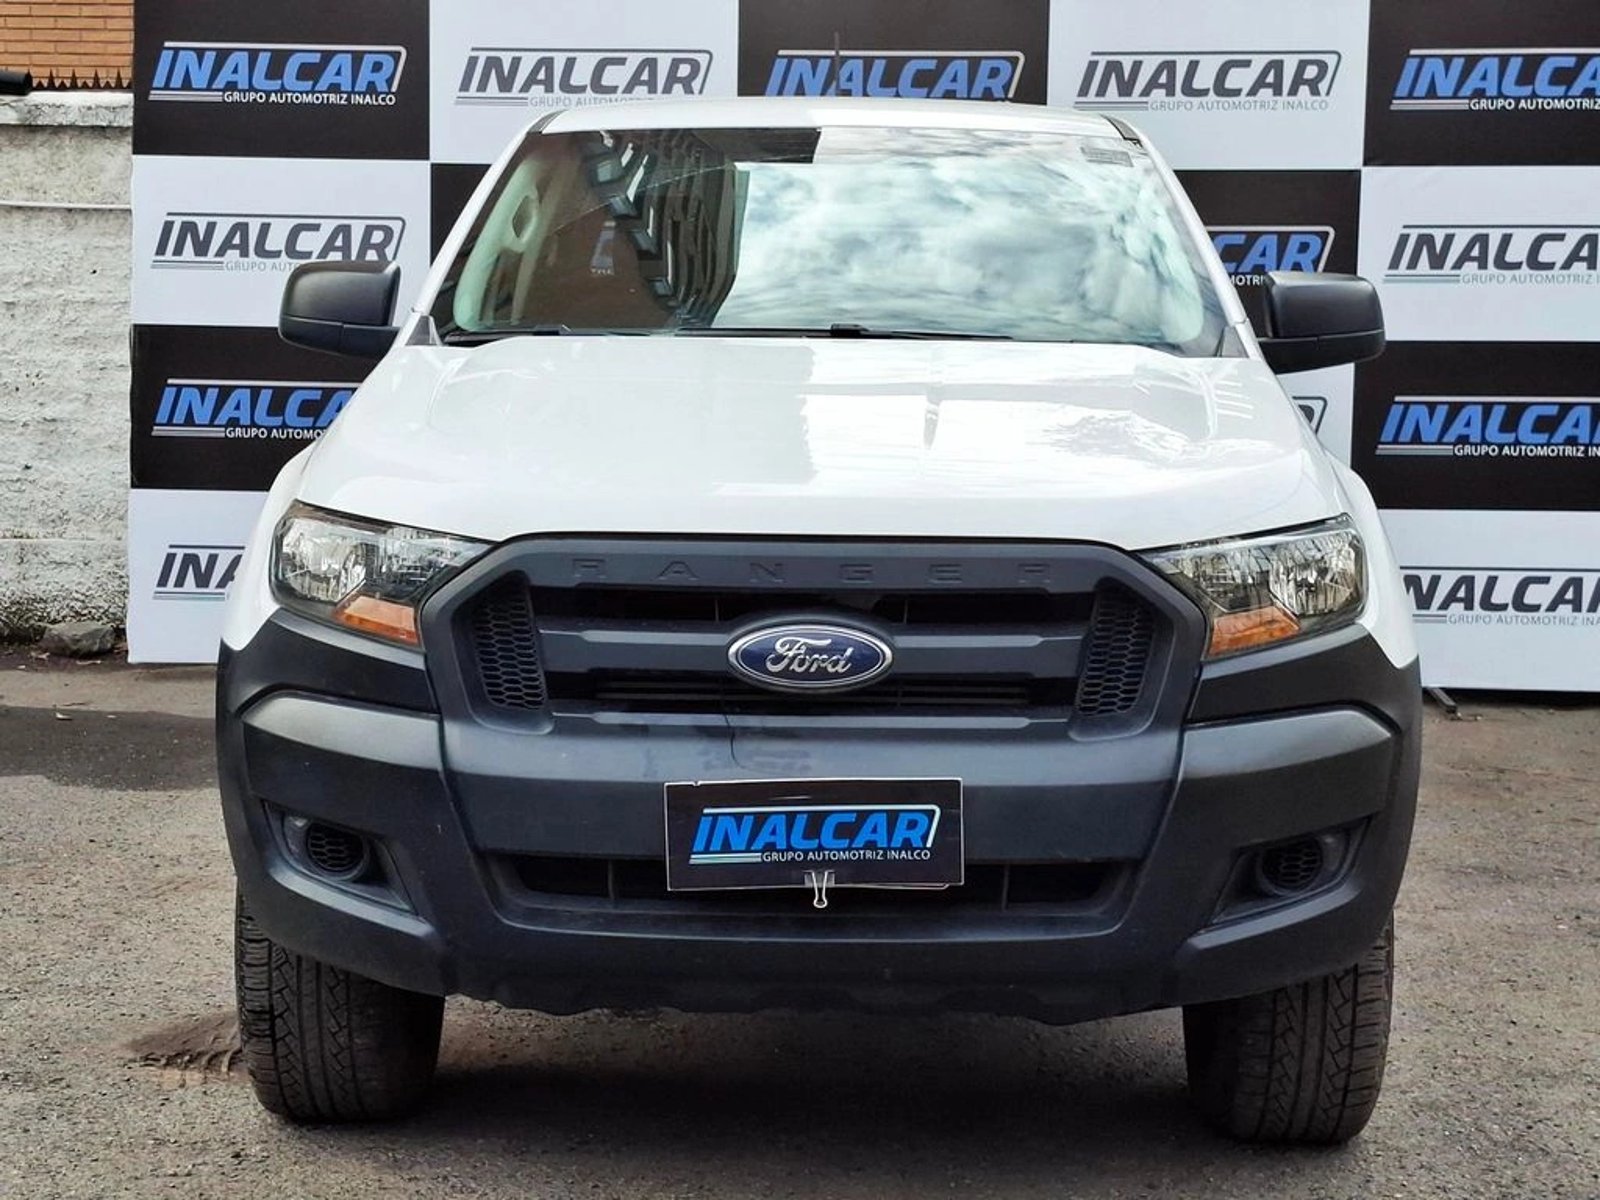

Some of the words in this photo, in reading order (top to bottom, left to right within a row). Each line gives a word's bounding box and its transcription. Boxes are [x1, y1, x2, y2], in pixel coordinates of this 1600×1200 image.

[152, 50, 396, 92] INALCAR
[458, 56, 701, 95] INALCAR
[765, 58, 1014, 98] INALCAR
[1077, 59, 1329, 97] INALCAR
[1394, 57, 1600, 97] INALCA
[224, 91, 266, 103] GRUPO
[269, 92, 348, 104] AUTOMOTRIZ
[351, 93, 396, 105] INALCO
[529, 96, 572, 107] GRUPO
[1150, 100, 1193, 111] GRUPO
[1196, 100, 1279, 111] AUTOMOTRIZ
[1282, 100, 1329, 110] INALCO
[1469, 98, 1515, 110] GRUPO
[1518, 98, 1600, 110] AUTOMOTRIZ
[155, 220, 395, 261] INALCAR
[1213, 233, 1323, 273] CAR
[1387, 233, 1599, 270] INALCA
[225, 261, 267, 272] GRUPO
[1462, 273, 1506, 284] GRUPO
[1509, 273, 1593, 284] AUTOMOTRIZ
[155, 387, 353, 427] INALCA
[1380, 404, 1600, 444] INALCA
[226, 427, 267, 438] GRUPO
[270, 428, 326, 439] AUTOMO
[1454, 445, 1499, 456] GRUPO
[1502, 445, 1585, 457] AUTOMOTRIZ
[156, 552, 243, 589] INA
[572, 558, 1051, 583] RANGER
[1448, 614, 1491, 625] GRUPO
[1496, 614, 1578, 625] AUTOMOTRIZ
[765, 636, 854, 673] Ford
[693, 812, 930, 851] INALCAR
[762, 851, 804, 862] GRUPO
[807, 851, 885, 862] AUTOMOTRIZ
[887, 849, 931, 861] INALCO
